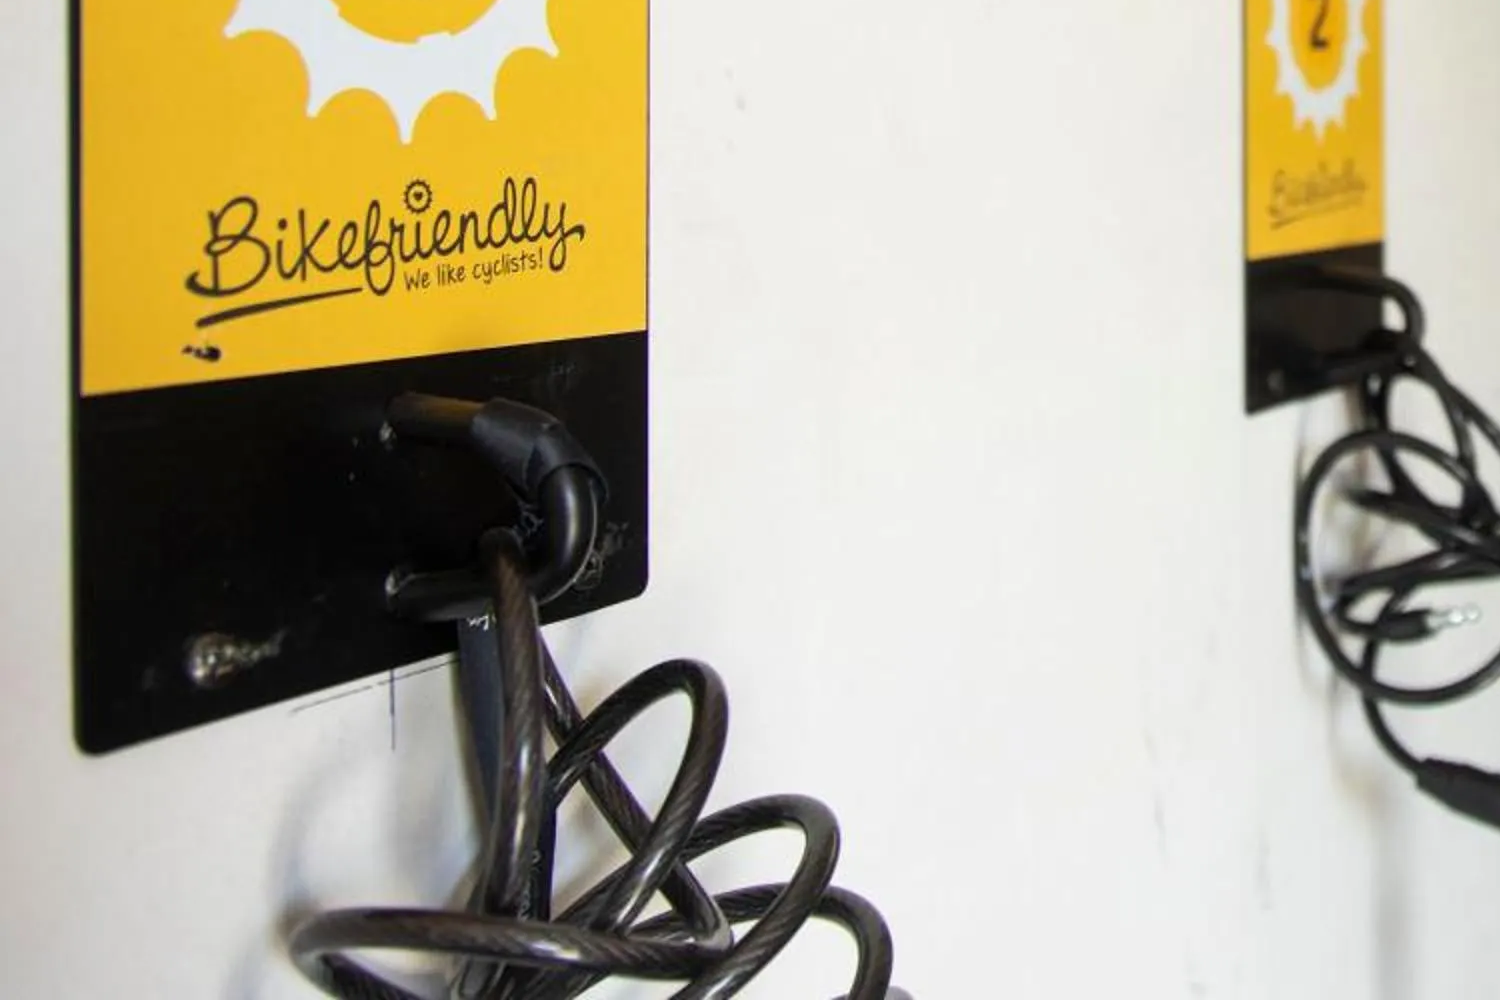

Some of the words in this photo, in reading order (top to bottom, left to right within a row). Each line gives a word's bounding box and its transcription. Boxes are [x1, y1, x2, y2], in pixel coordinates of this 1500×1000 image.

[184, 176, 585, 297] Bikefriendly
[404, 268, 431, 291] We
[437, 262, 467, 286] like
[471, 247, 544, 285] cyclists!
